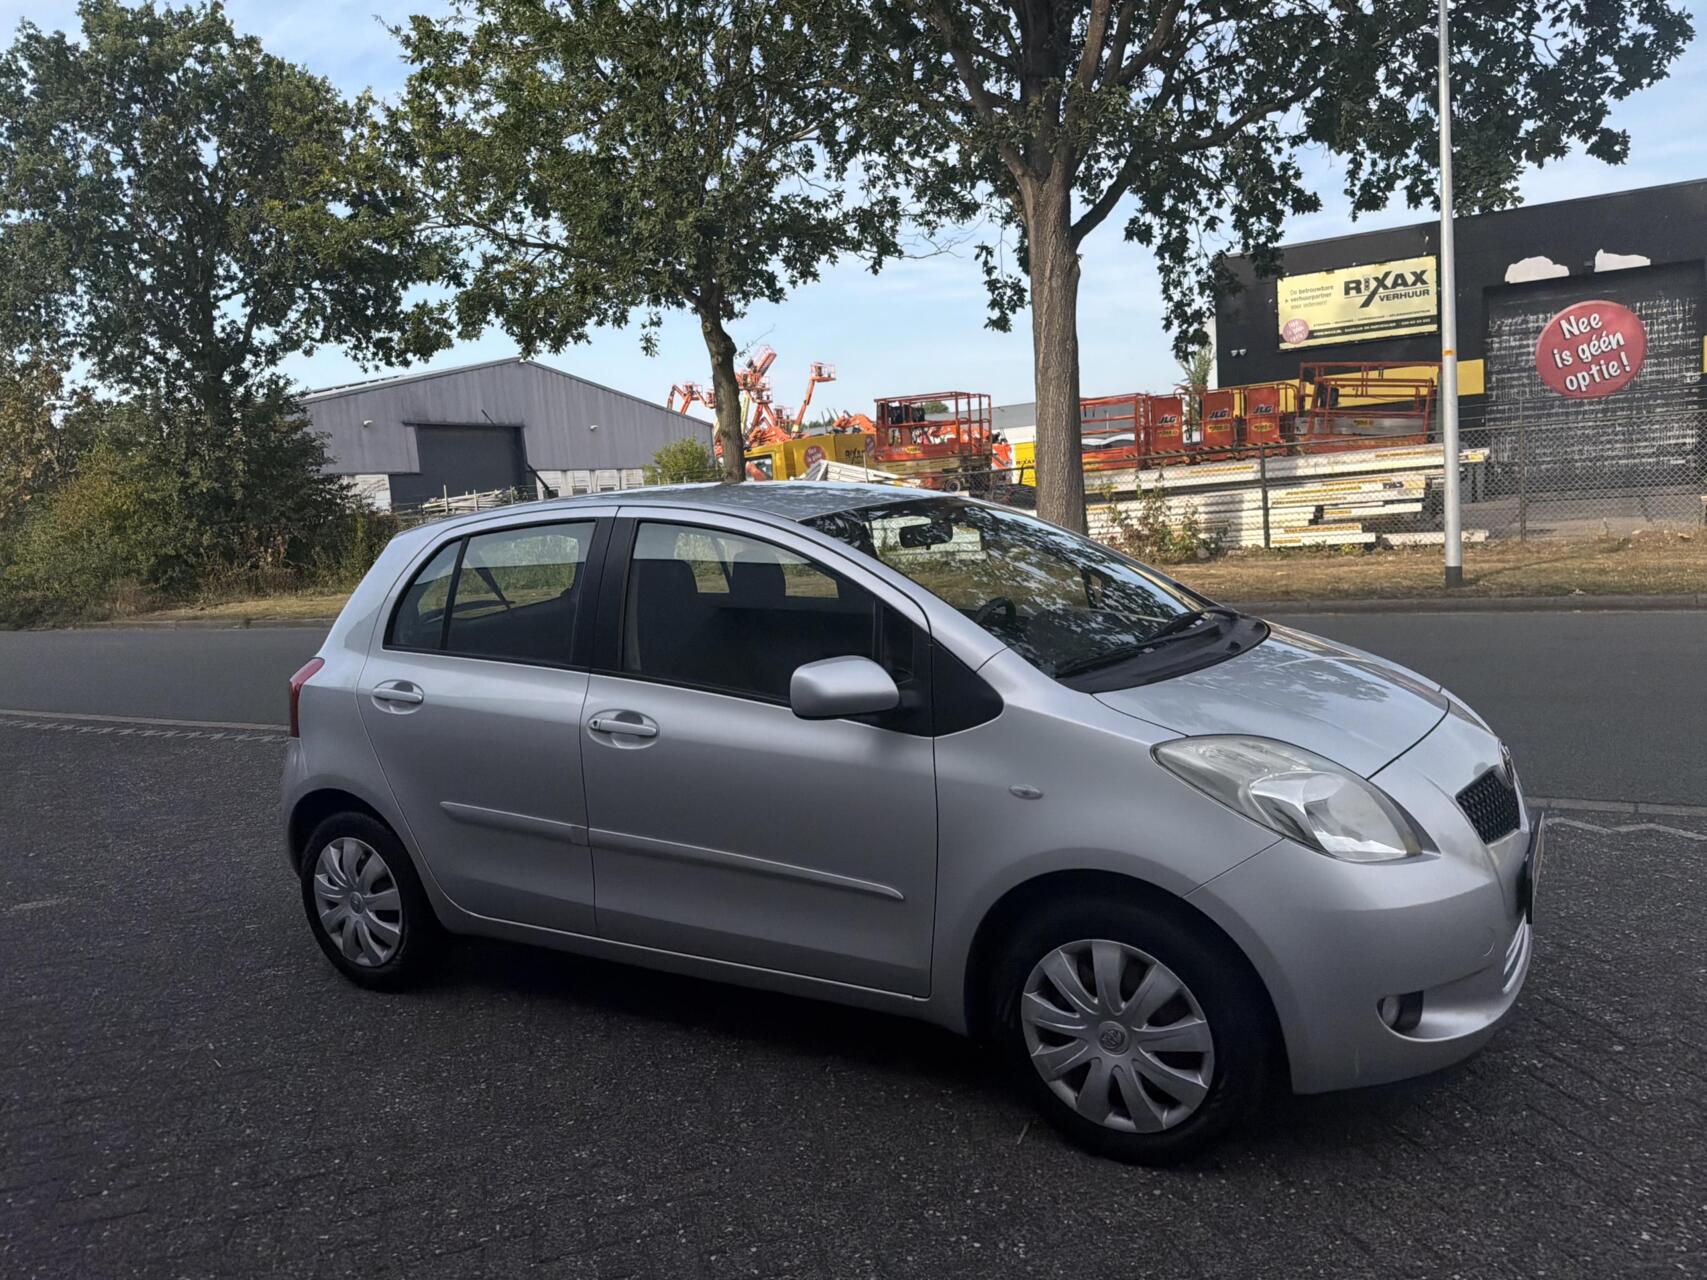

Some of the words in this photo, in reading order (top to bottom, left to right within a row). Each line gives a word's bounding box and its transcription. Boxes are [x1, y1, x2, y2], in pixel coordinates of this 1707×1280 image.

[1379, 289, 1430, 302] VERHUUR
[1559, 312, 1603, 340] Nee
[1553, 348, 1574, 369] is
[1577, 330, 1625, 363] géén
[1209, 410, 1228, 419] JLG
[1252, 405, 1272, 414] JLG
[1158, 415, 1176, 424] JLG
